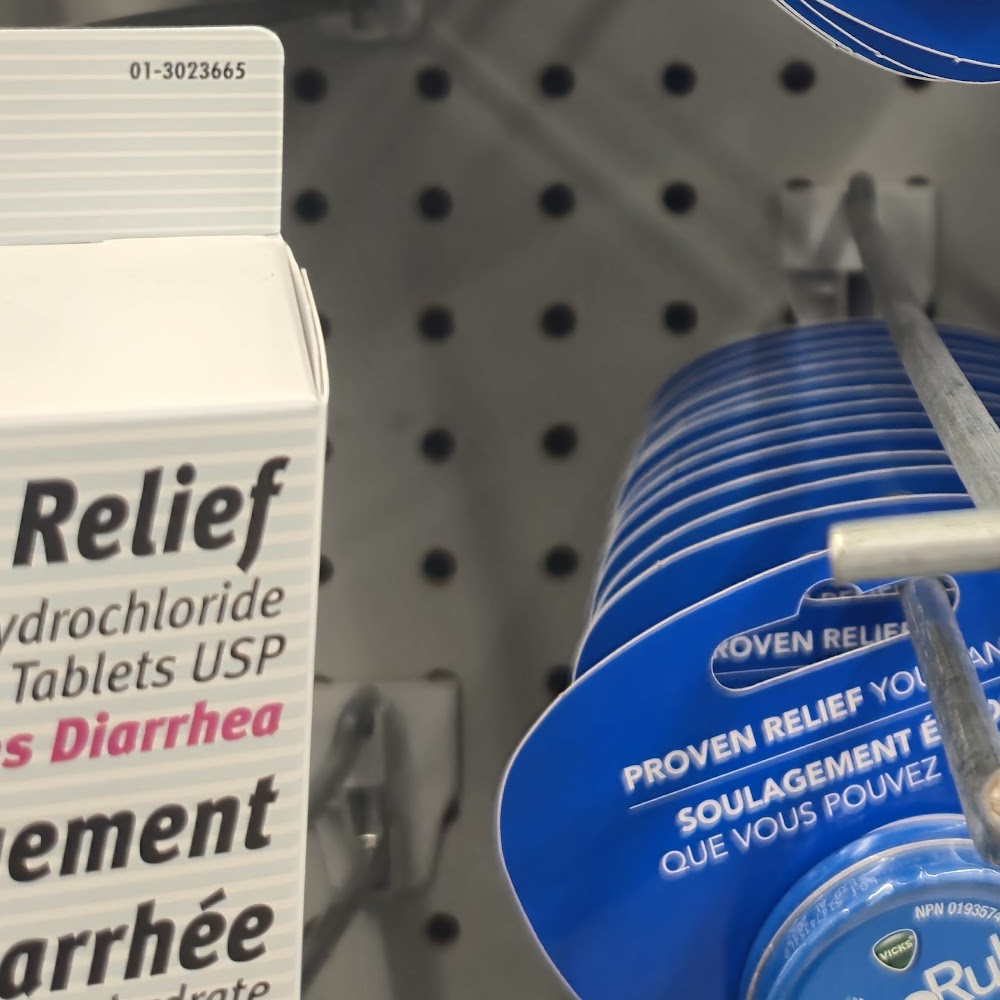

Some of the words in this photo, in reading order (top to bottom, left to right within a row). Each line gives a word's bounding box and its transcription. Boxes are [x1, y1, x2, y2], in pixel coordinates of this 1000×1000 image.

[130, 61, 247, 81] 01-3023665
[12, 455, 291, 574] Relief
[12, 650, 177, 704] Tablets
[192, 633, 287, 684] USP
[713, 629, 814, 660] OVEN
[50, 700, 284, 764] Diarrhea
[623, 725, 757, 792] PROVEN
[763, 687, 865, 743] RELIEF
[660, 841, 729, 875] QUE
[731, 804, 817, 855] VOUS
[825, 755, 942, 816] POUVEZ
[677, 728, 912, 834] SOULAGEMENT
[0, 773, 280, 882] ement
[914, 903, 944, 920] NPN
